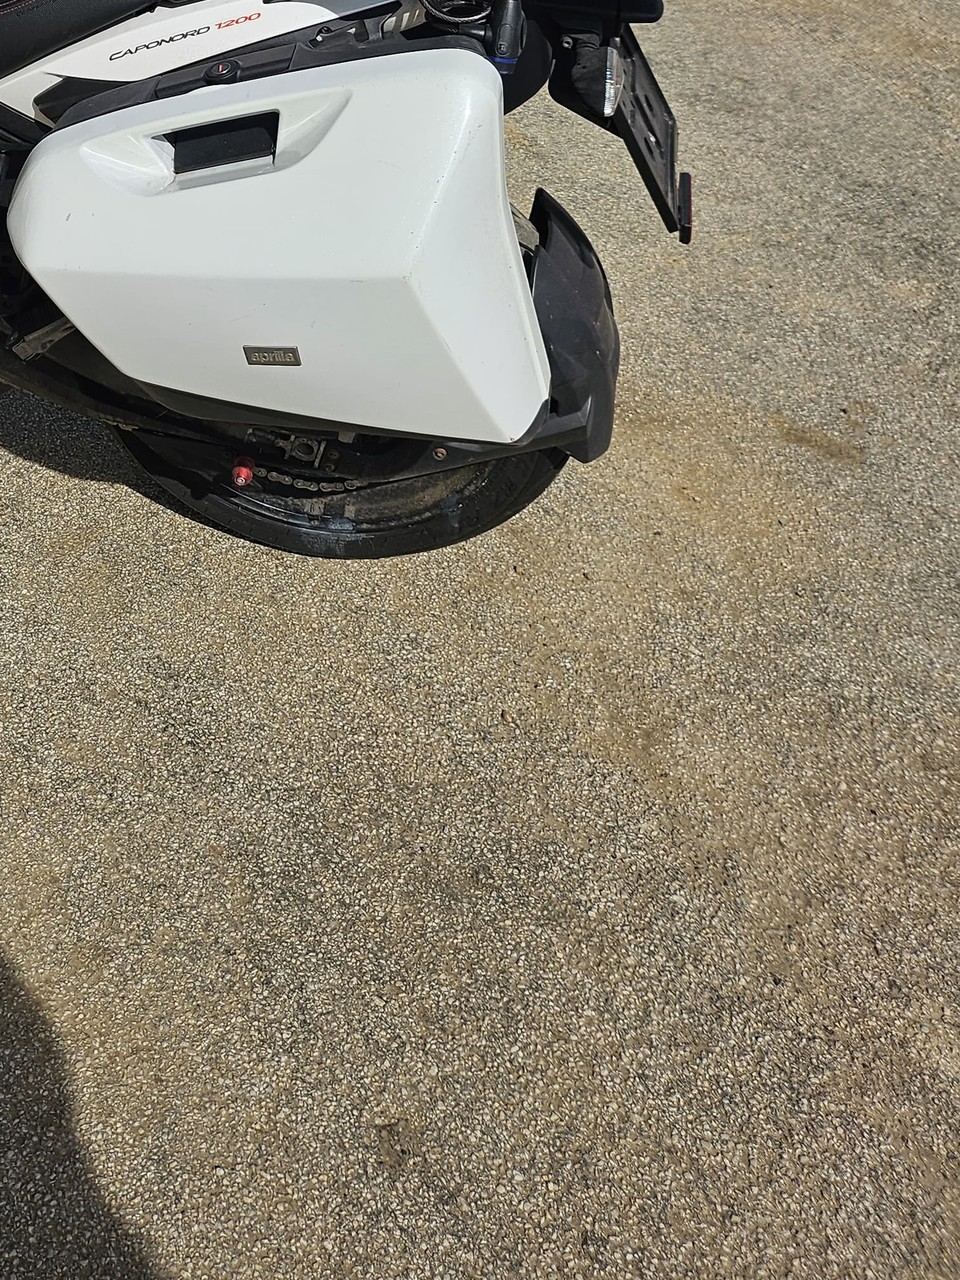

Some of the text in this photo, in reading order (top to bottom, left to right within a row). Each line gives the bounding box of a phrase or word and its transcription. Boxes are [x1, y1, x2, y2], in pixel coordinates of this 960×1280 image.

[109, 12, 261, 61] CAPONORD 1200
[250, 350, 296, 363] aprilia
